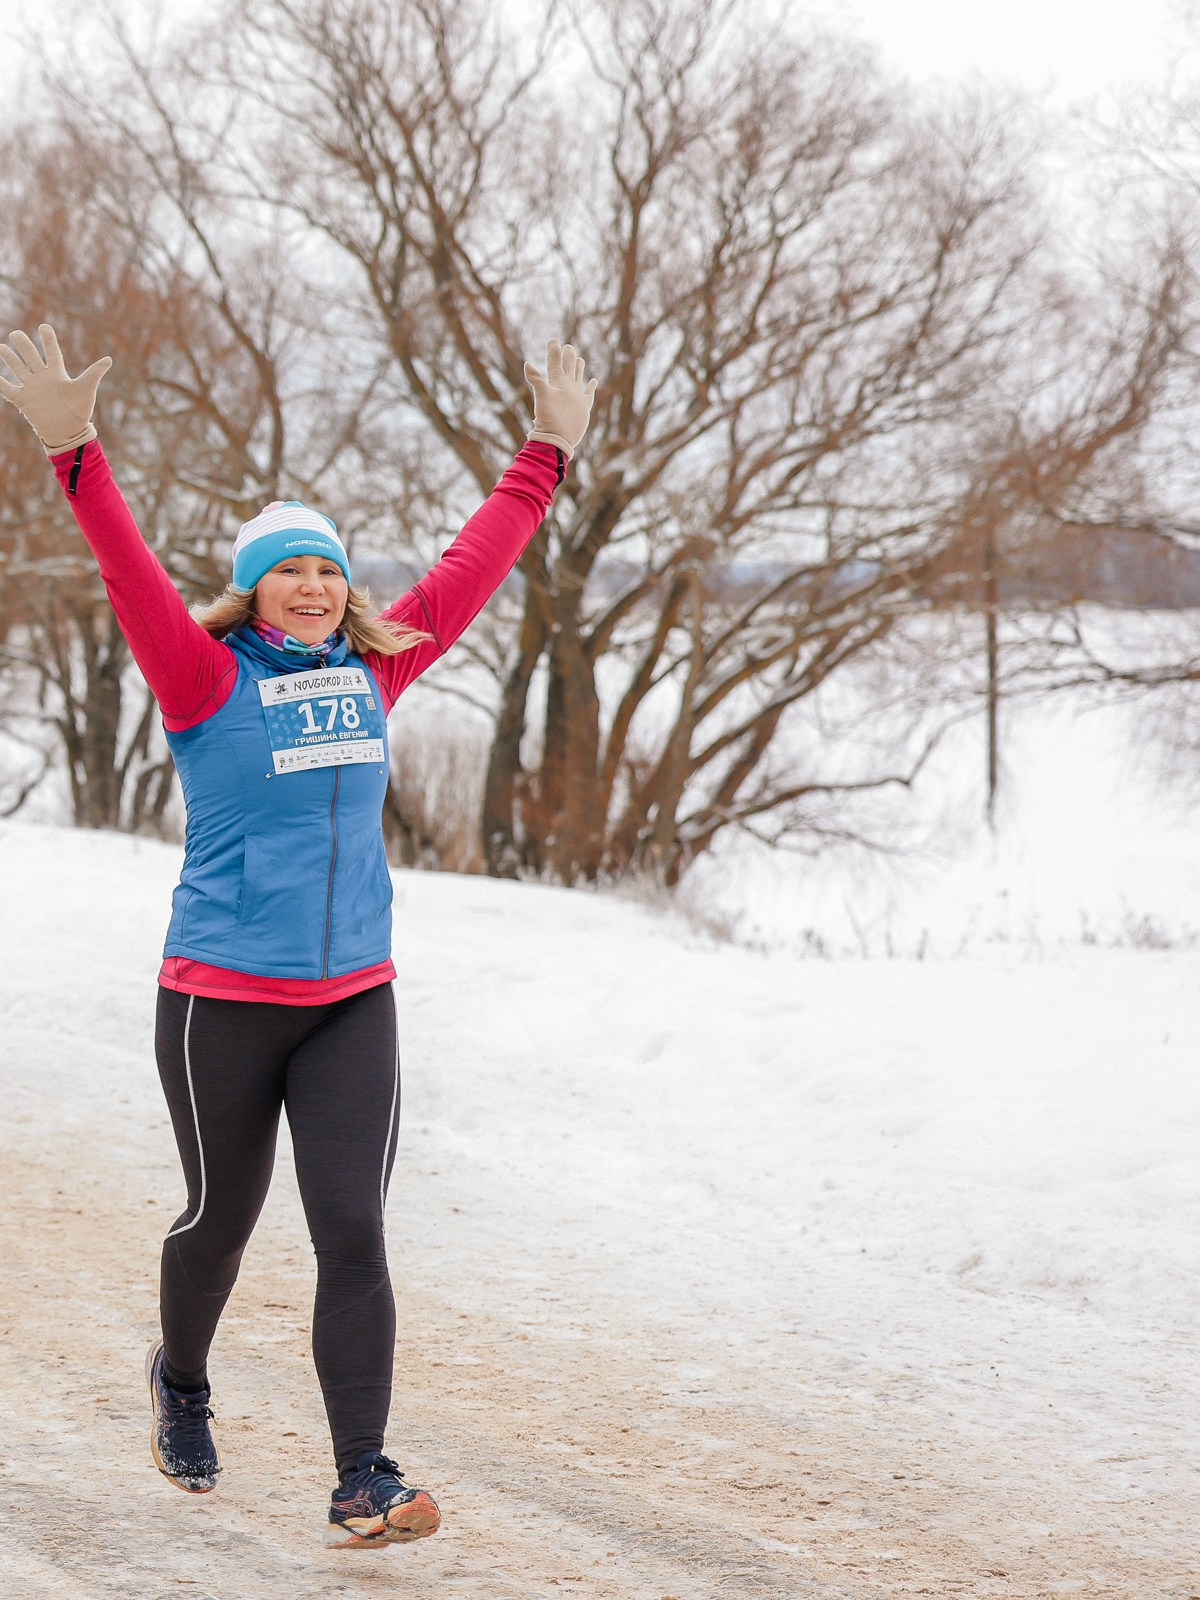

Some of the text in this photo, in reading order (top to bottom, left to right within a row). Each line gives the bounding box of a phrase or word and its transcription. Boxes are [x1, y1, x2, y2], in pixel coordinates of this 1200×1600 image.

[285, 540, 332, 549] NORDSKI
[294, 676, 341, 692] NOVGOROD
[297, 697, 361, 735] 178
[294, 730, 369, 746] ГРИШИНА ЕВГЕНИЯ
